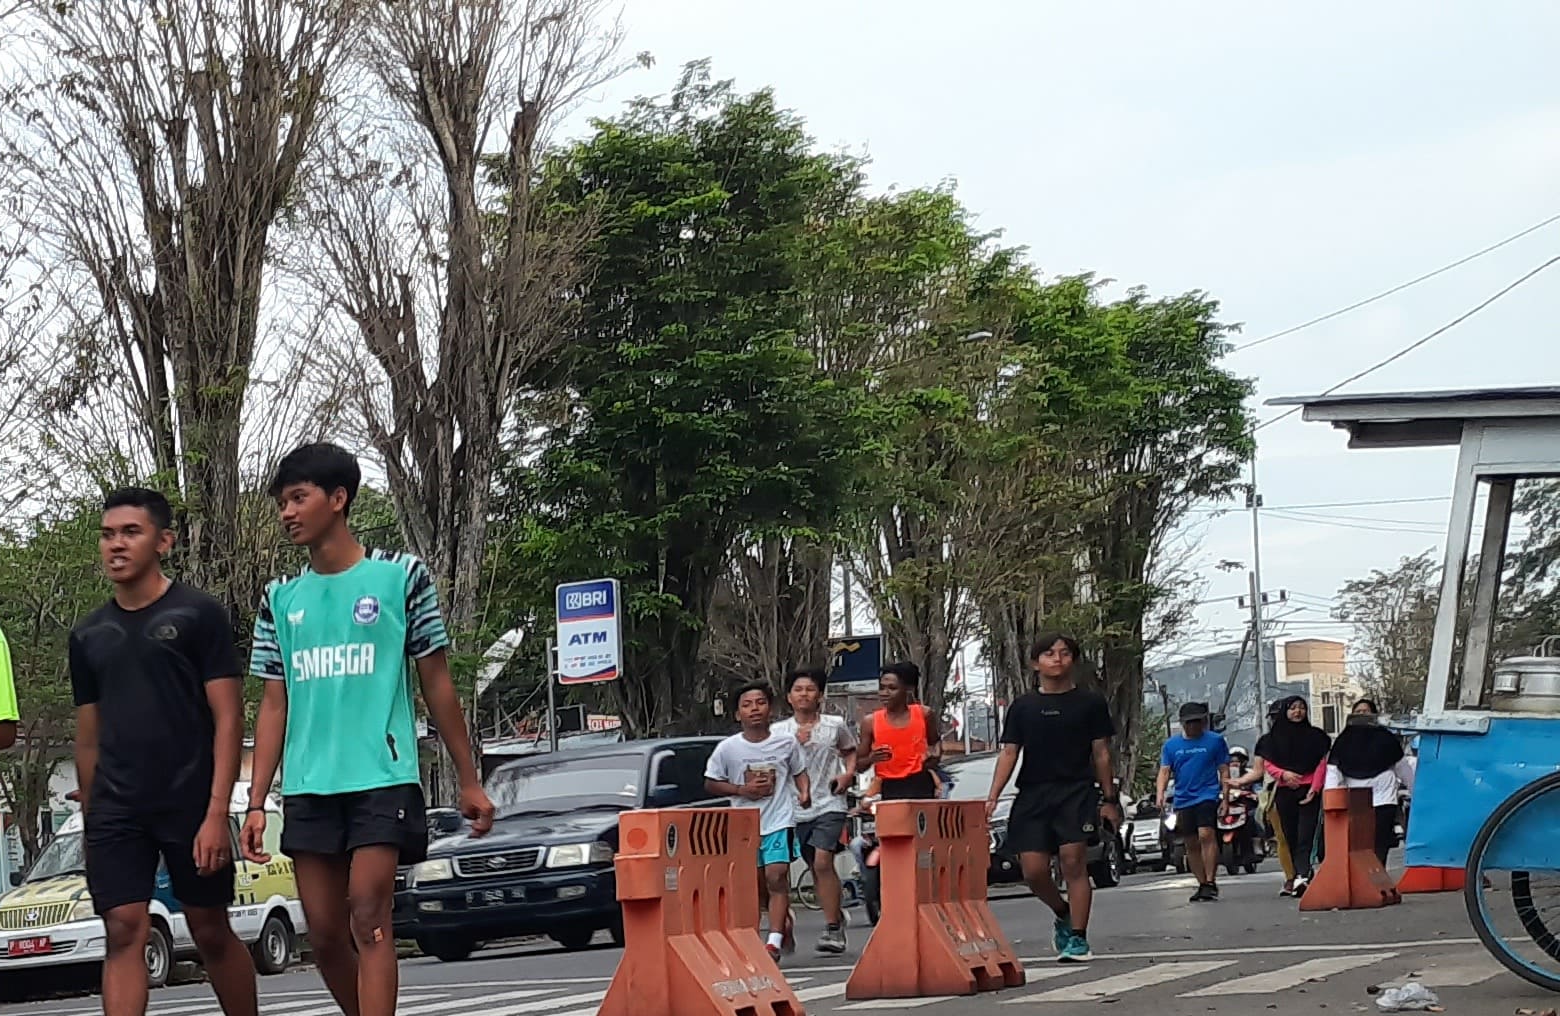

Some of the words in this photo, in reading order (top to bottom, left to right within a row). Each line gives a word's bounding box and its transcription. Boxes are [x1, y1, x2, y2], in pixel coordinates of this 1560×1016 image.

[582, 590, 607, 606] BRI
[568, 631, 607, 646] ATM
[292, 642, 375, 682] SMASGA
